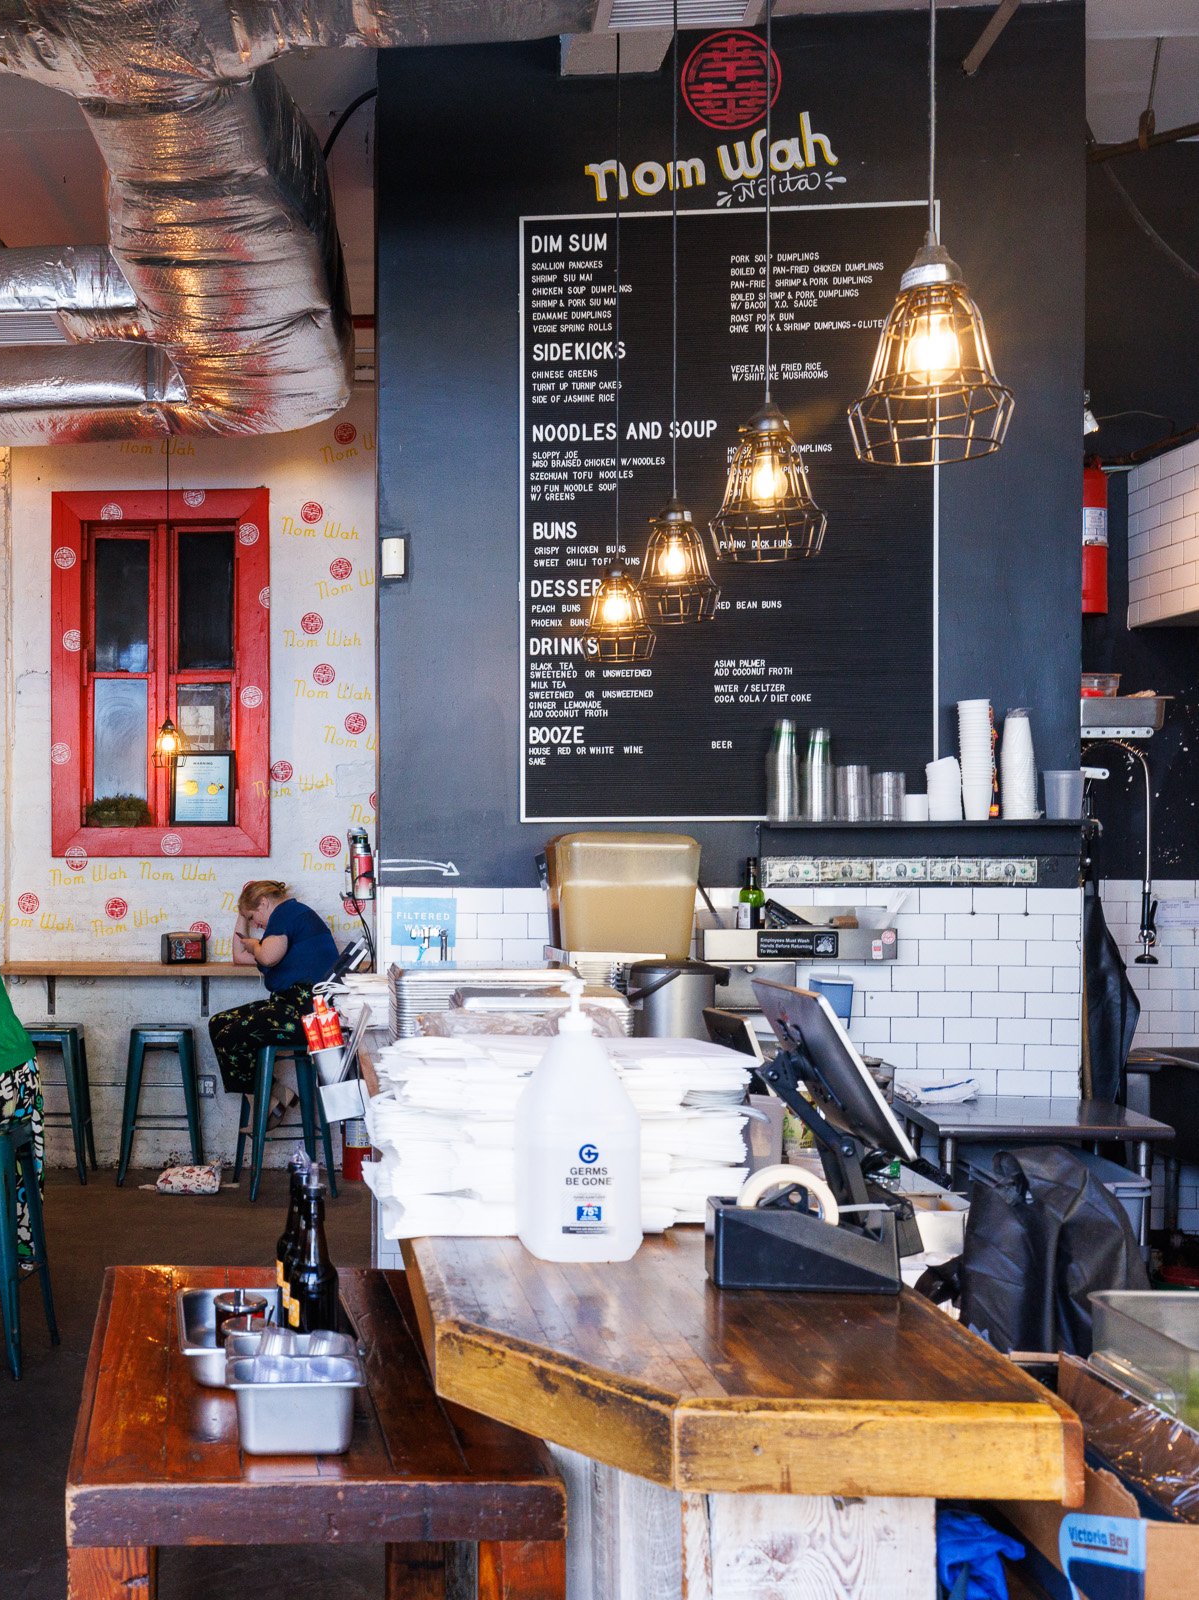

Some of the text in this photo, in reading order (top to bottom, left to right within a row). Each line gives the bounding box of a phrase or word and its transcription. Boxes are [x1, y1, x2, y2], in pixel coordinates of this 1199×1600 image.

[717, 111, 839, 181] Wah
[532, 233, 607, 253] DIM SUM
[730, 252, 820, 263] PORK DUMPLINGS
[532, 261, 603, 271] SCALLION PANCAKES
[730, 262, 884, 276] BOILED PAN-FRIED CHICKEN DUMPLINGS
[532, 275, 557, 283] SHRIMP
[563, 274, 576, 282] SIU
[775, 276, 873, 287] SHRIMP PORK DUMPLINGS
[532, 287, 563, 296] CHICKEN
[730, 289, 859, 302] BOILED PORK DUMPLINGS
[532, 298, 616, 308] SHRIMP PORK SIU MAI
[794, 299, 818, 308] SAUCE
[532, 311, 612, 320] EDAMAME DUMPLINGS
[730, 313, 794, 322] ROAST BUN
[533, 323, 612, 333] VEGGIE SPRING ROLLS
[729, 323, 810, 333] CHIVE SHRIMP
[532, 341, 626, 361] SIDEKICKS
[781, 362, 821, 372] FRIED RICE
[532, 370, 598, 379] CHINESE GREENS
[783, 371, 828, 380] MUSHROOMS
[532, 381, 622, 391] TURNT UP TURNIP CAKES
[532, 394, 615, 404] SIDE OF JASMINE RICE
[532, 420, 717, 442] NOODLES AND SOUP
[533, 450, 578, 459] SLOPPY JOE
[532, 457, 665, 468] MISO BRAISED CHICKEN W/NOODLES
[530, 471, 593, 480] SZECHUAN TOFU
[531, 483, 617, 493] HO FUN NOODLE SOUP
[530, 493, 542, 501] W/
[282, 516, 359, 540] Nom Wah
[533, 521, 577, 540] BUNS
[534, 546, 599, 555] CRISPY CHICKEN
[534, 558, 586, 567] SWEET CHILI
[315, 581, 353, 600] Nom
[530, 579, 604, 598] DESSER
[532, 604, 581, 613] PEACH BUNS
[716, 600, 782, 610] RED BEAN BUNS
[531, 619, 562, 627] PHOENIX
[283, 629, 362, 647] Nom Wah
[529, 637, 598, 655] DRINKS
[560, 662, 574, 670] TEA
[714, 659, 766, 668] ASIAN PALMER
[530, 669, 652, 679] SWEETENED OR UNSWEETENED
[732, 668, 765, 676] COCONUT
[768, 667, 793, 675] FROTH
[294, 679, 373, 701] Nom Wah
[531, 681, 548, 689] MILK
[714, 685, 738, 693] WATER
[529, 691, 574, 699] SWEETENED
[602, 690, 653, 698] UNSWEETENED
[771, 694, 788, 702] DIET
[791, 694, 812, 702] COKE
[529, 701, 601, 709] GINGER LEMONADE
[529, 709, 608, 718] ADD COCONUT FROTH
[324, 725, 358, 749] Nom
[529, 726, 584, 744] BOOZE
[711, 741, 733, 749] BEER
[529, 746, 643, 755] HOUSE RED OR WHITE WINE
[529, 758, 546, 766] SAKE
[50, 864, 127, 886] Nom Wah
[140, 862, 217, 882] Nom Wah
[397, 912, 450, 921] FILTERED
[39, 912, 75, 932] Wah
[570, 1167, 608, 1176] GERMS
[565, 1178, 612, 1186] BE GONE
[1068, 1526, 1108, 1545] Victoria
